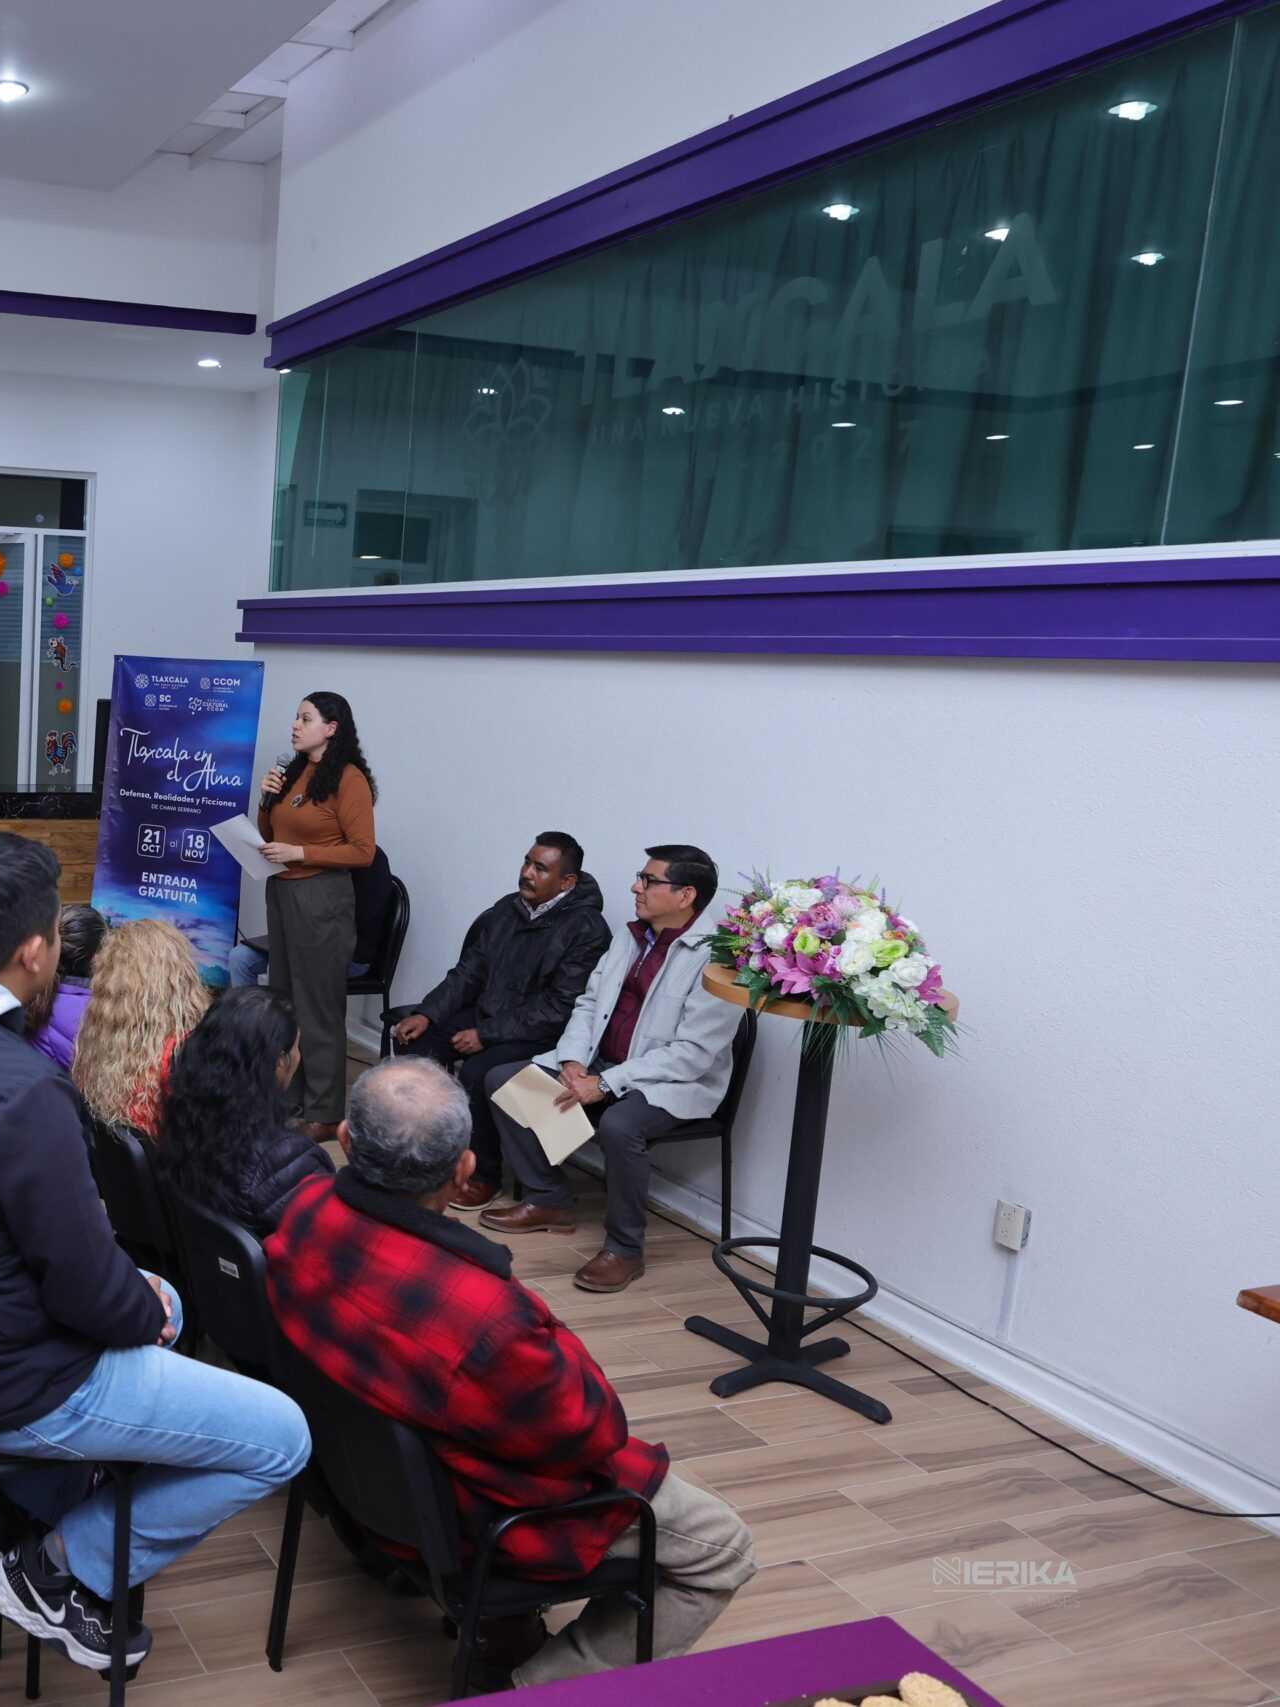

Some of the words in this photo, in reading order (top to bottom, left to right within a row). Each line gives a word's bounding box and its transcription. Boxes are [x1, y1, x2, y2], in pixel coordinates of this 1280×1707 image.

[151, 675, 189, 684] TLAXCALA
[213, 678, 240, 686] CCOM
[159, 694, 172, 703] SC
[119, 727, 190, 766] Tlaxcala
[193, 749, 212, 764] en
[166, 759, 183, 782] el
[183, 753, 244, 792] Alma
[153, 791, 195, 804] Realidades
[201, 796, 238, 808] Ficciones
[143, 829, 161, 844] 21
[170, 840, 177, 848] al
[187, 834, 205, 849] 18
[141, 844, 161, 854] OCT
[184, 849, 205, 859] NOV
[141, 871, 198, 889] ENTRADA
[138, 886, 198, 905] GRATUITA
